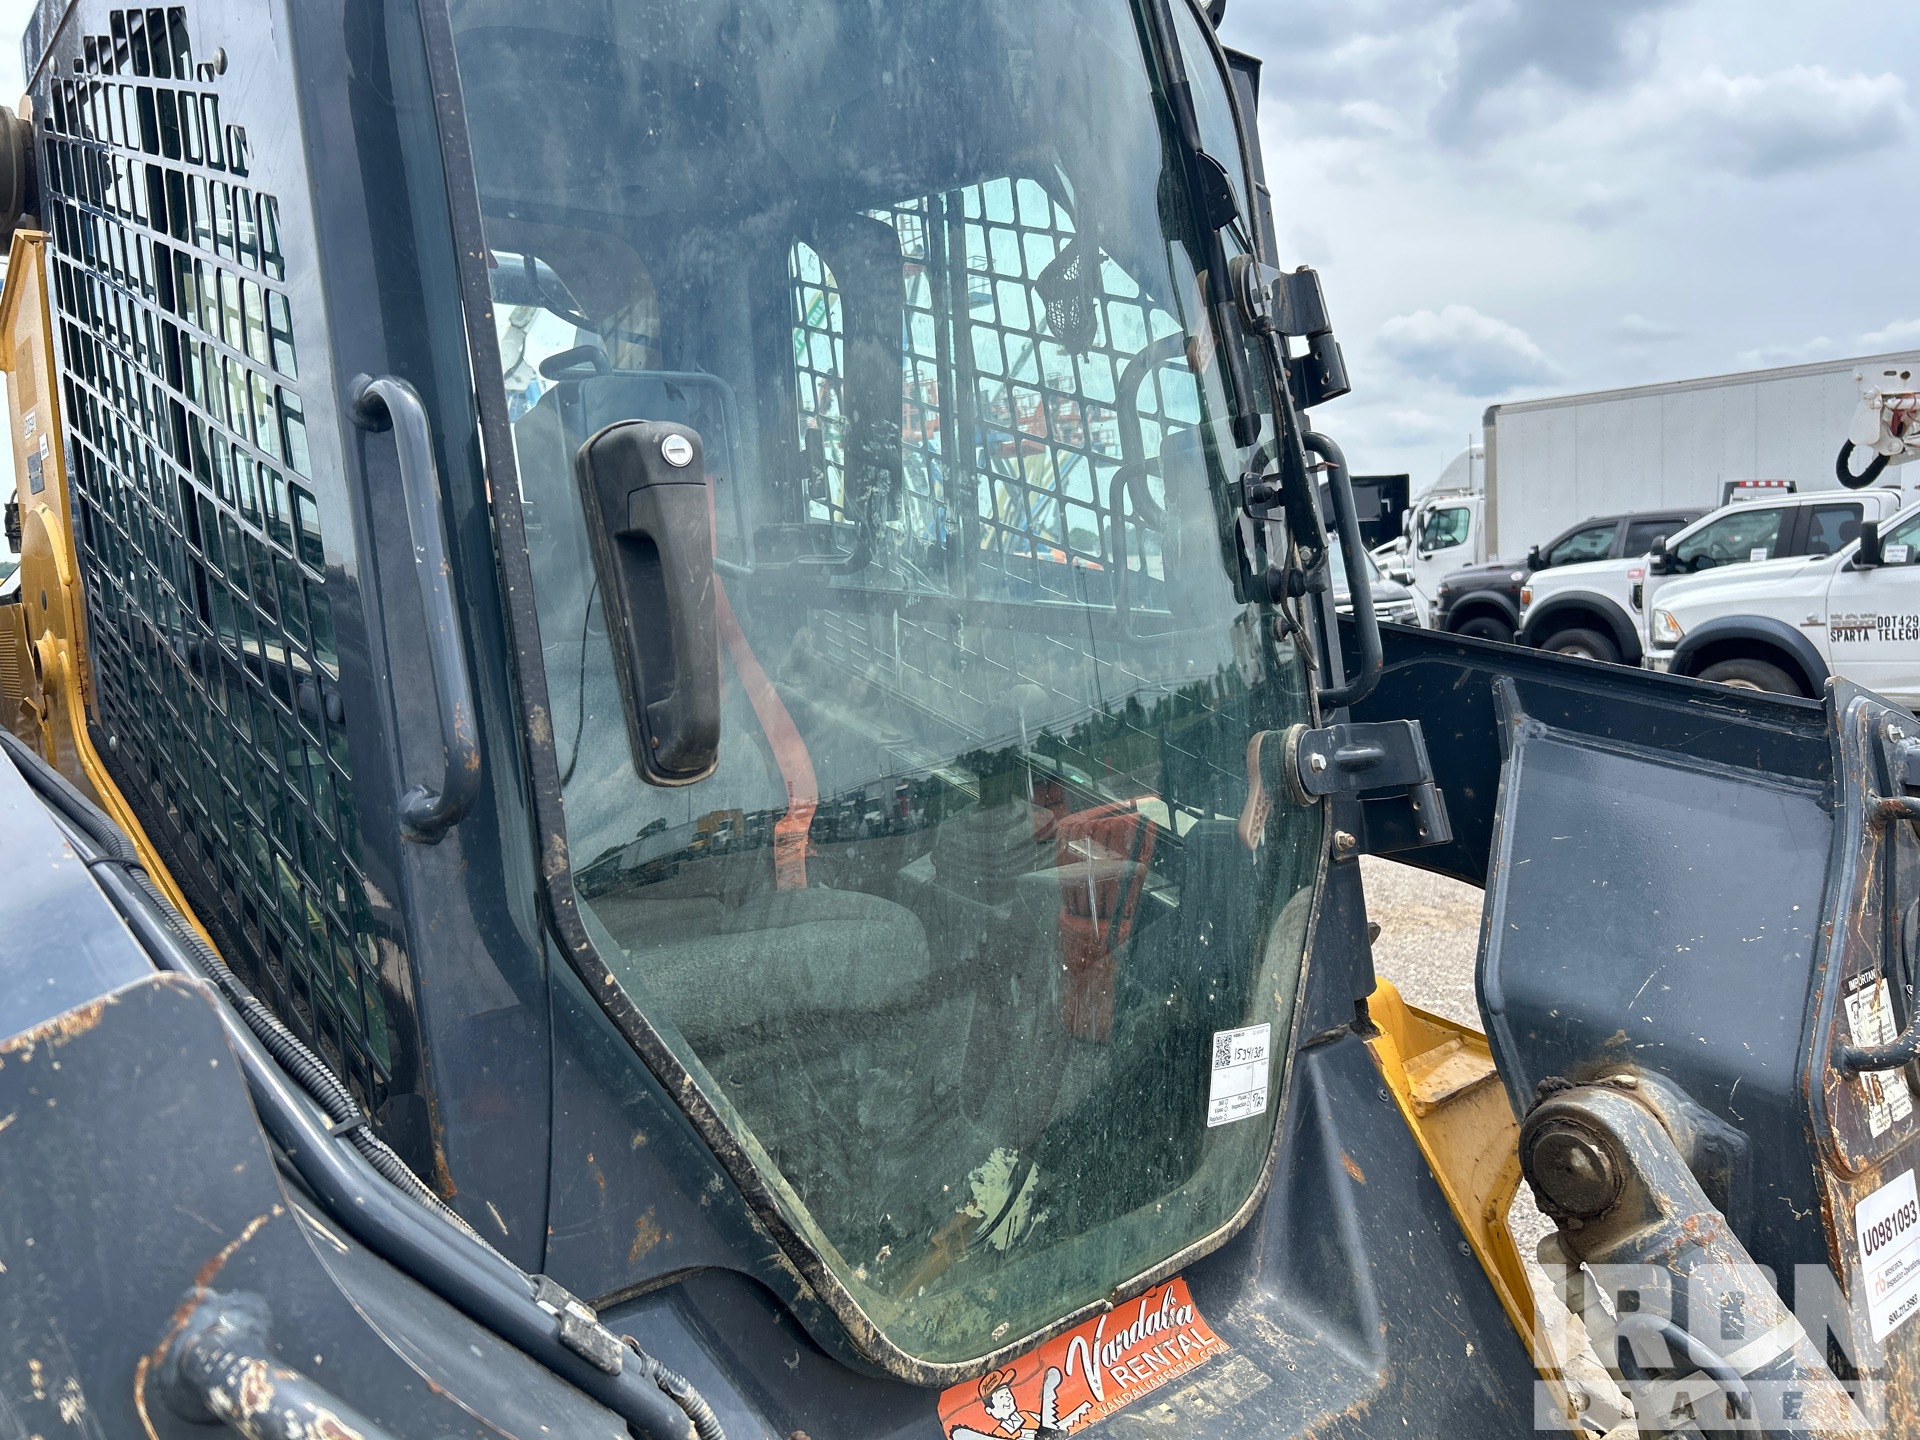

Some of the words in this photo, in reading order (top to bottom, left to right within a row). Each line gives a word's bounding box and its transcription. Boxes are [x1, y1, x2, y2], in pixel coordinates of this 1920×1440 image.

[1830, 629, 1870, 642] SPARTA
[1878, 628, 1920, 641] TELECO
[1848, 968, 1878, 992] IMPORTAN
[1862, 1200, 1918, 1256] U0981093
[1065, 1285, 1194, 1402] Vandalia
[1109, 1327, 1216, 1389] RENTAL
[1096, 1342, 1227, 1416] VANDALIARENTAL.COM
